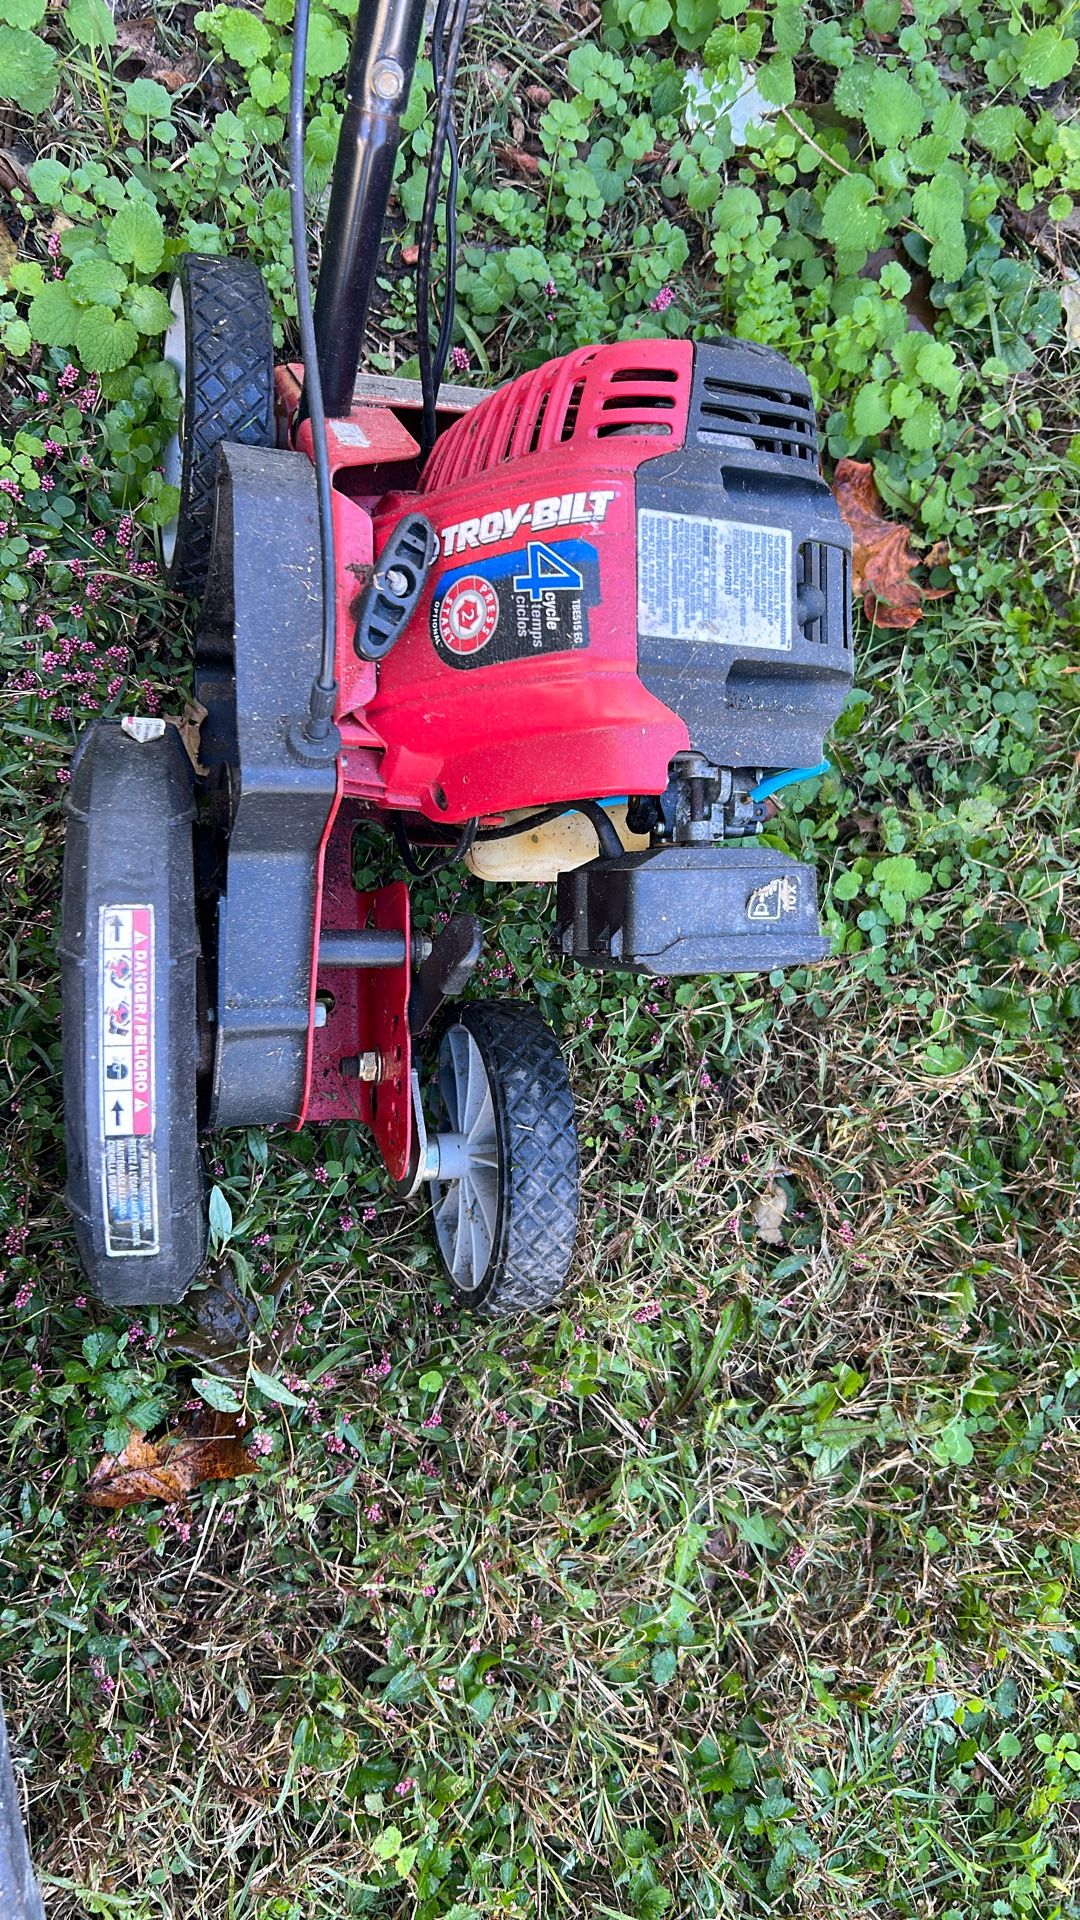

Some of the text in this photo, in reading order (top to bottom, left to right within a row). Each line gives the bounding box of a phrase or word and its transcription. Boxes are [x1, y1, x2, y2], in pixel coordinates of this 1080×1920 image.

[441, 490, 615, 557] TROY-BILT
[513, 541, 584, 602] 4
[441, 596, 456, 645] START
[461, 610, 474, 622] 2
[479, 585, 497, 636] PRESS
[516, 595, 530, 638] ciclos
[530, 603, 543, 648] temps
[544, 591, 561, 630] cycle
[572, 598, 583, 644] TBE515 EC
[129, 1140, 138, 1163] RESTEZ
